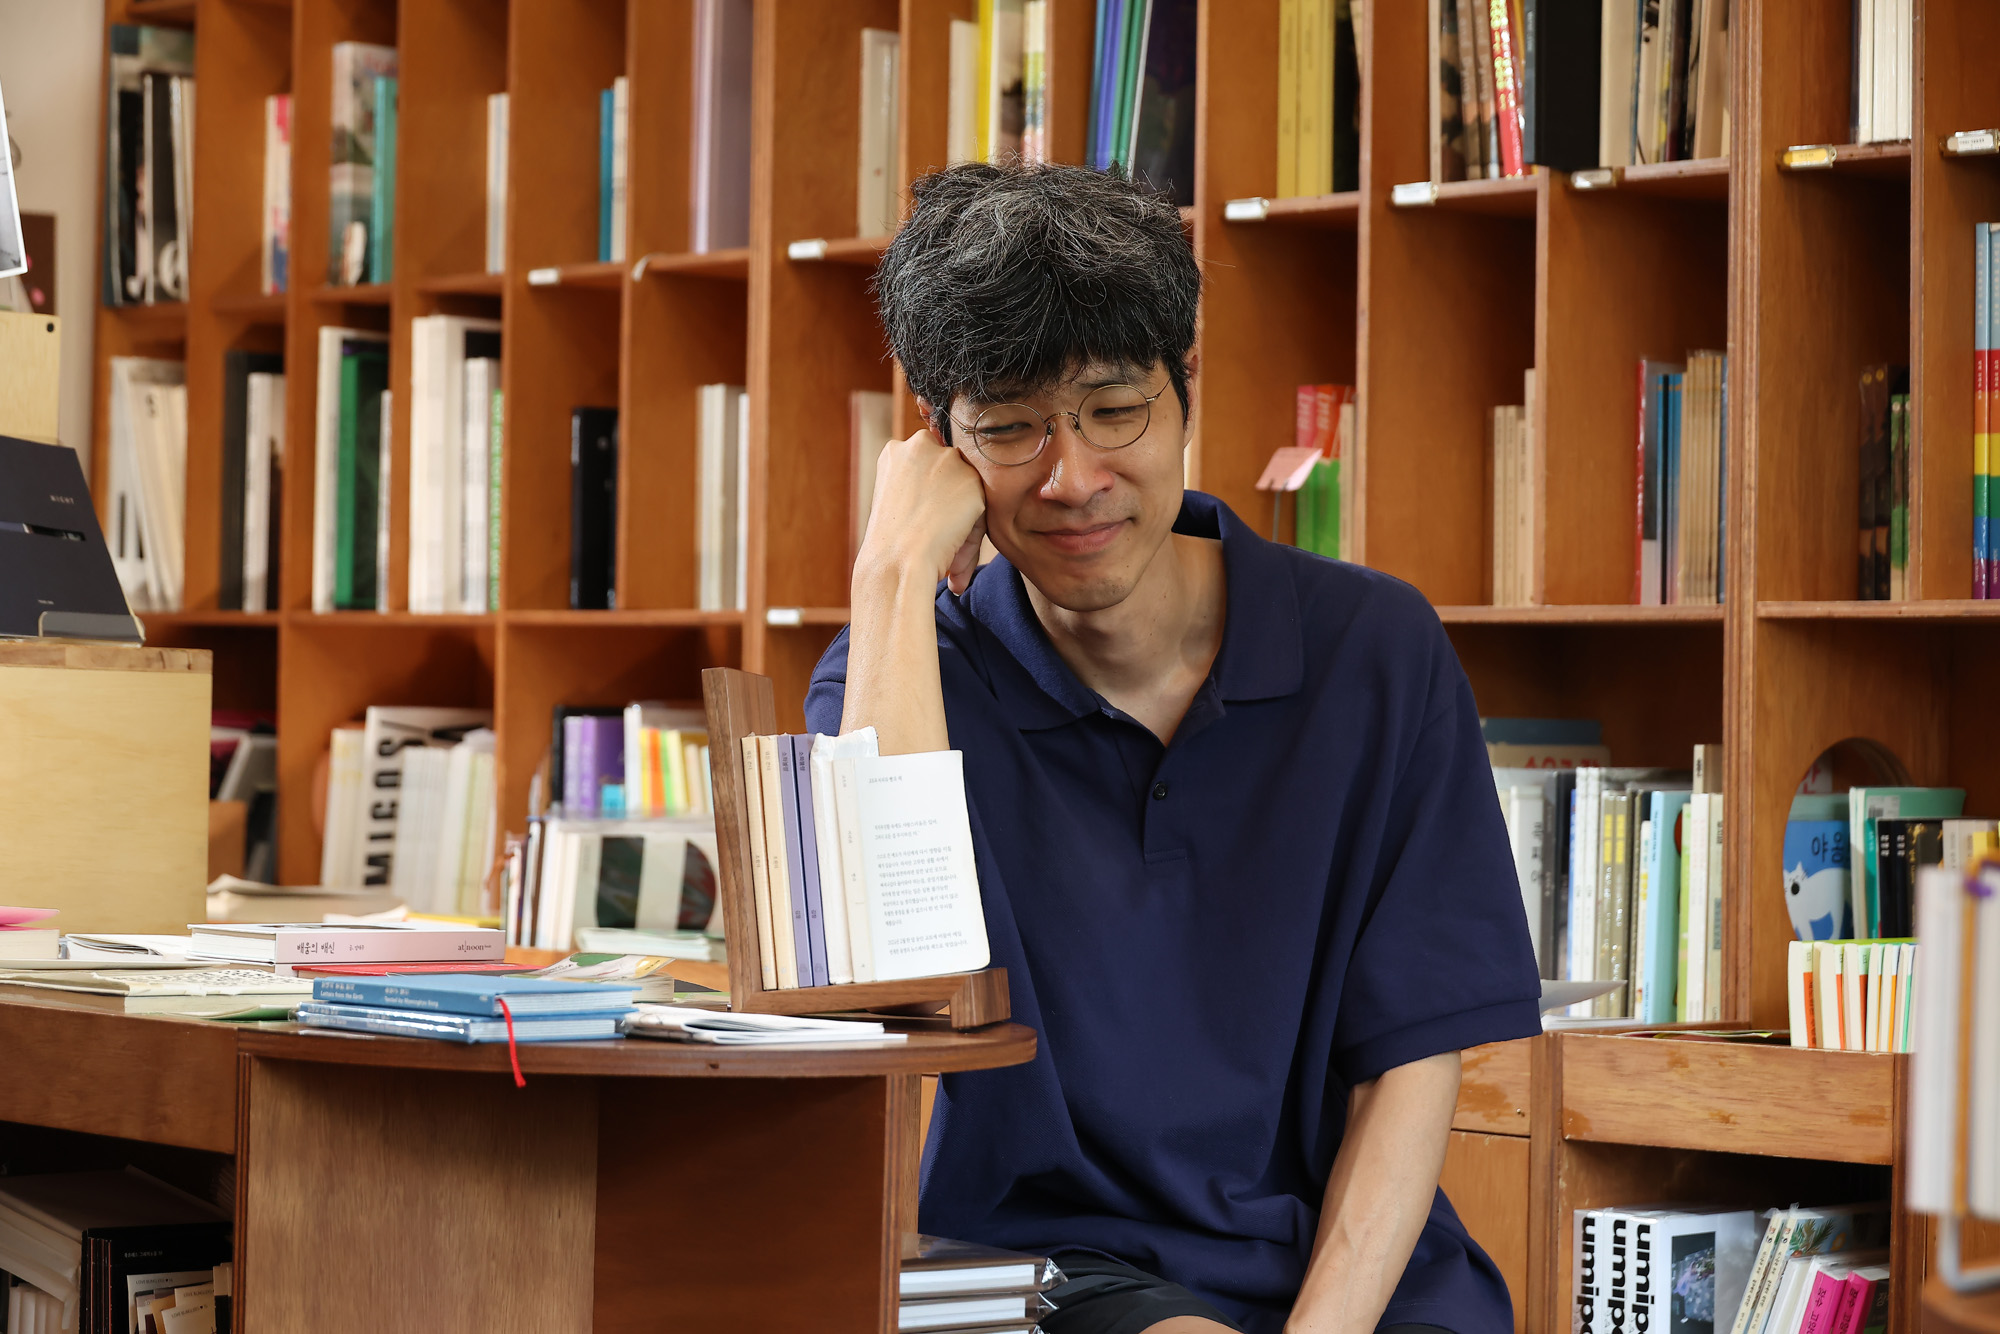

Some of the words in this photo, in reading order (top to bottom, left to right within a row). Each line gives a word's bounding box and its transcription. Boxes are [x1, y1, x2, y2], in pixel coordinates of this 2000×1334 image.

[49, 494, 75, 505] NIGHT
[296, 941, 318, 955] 배웅의
[320, 941, 335, 954] 배신
[1632, 1224, 1655, 1334] umip
